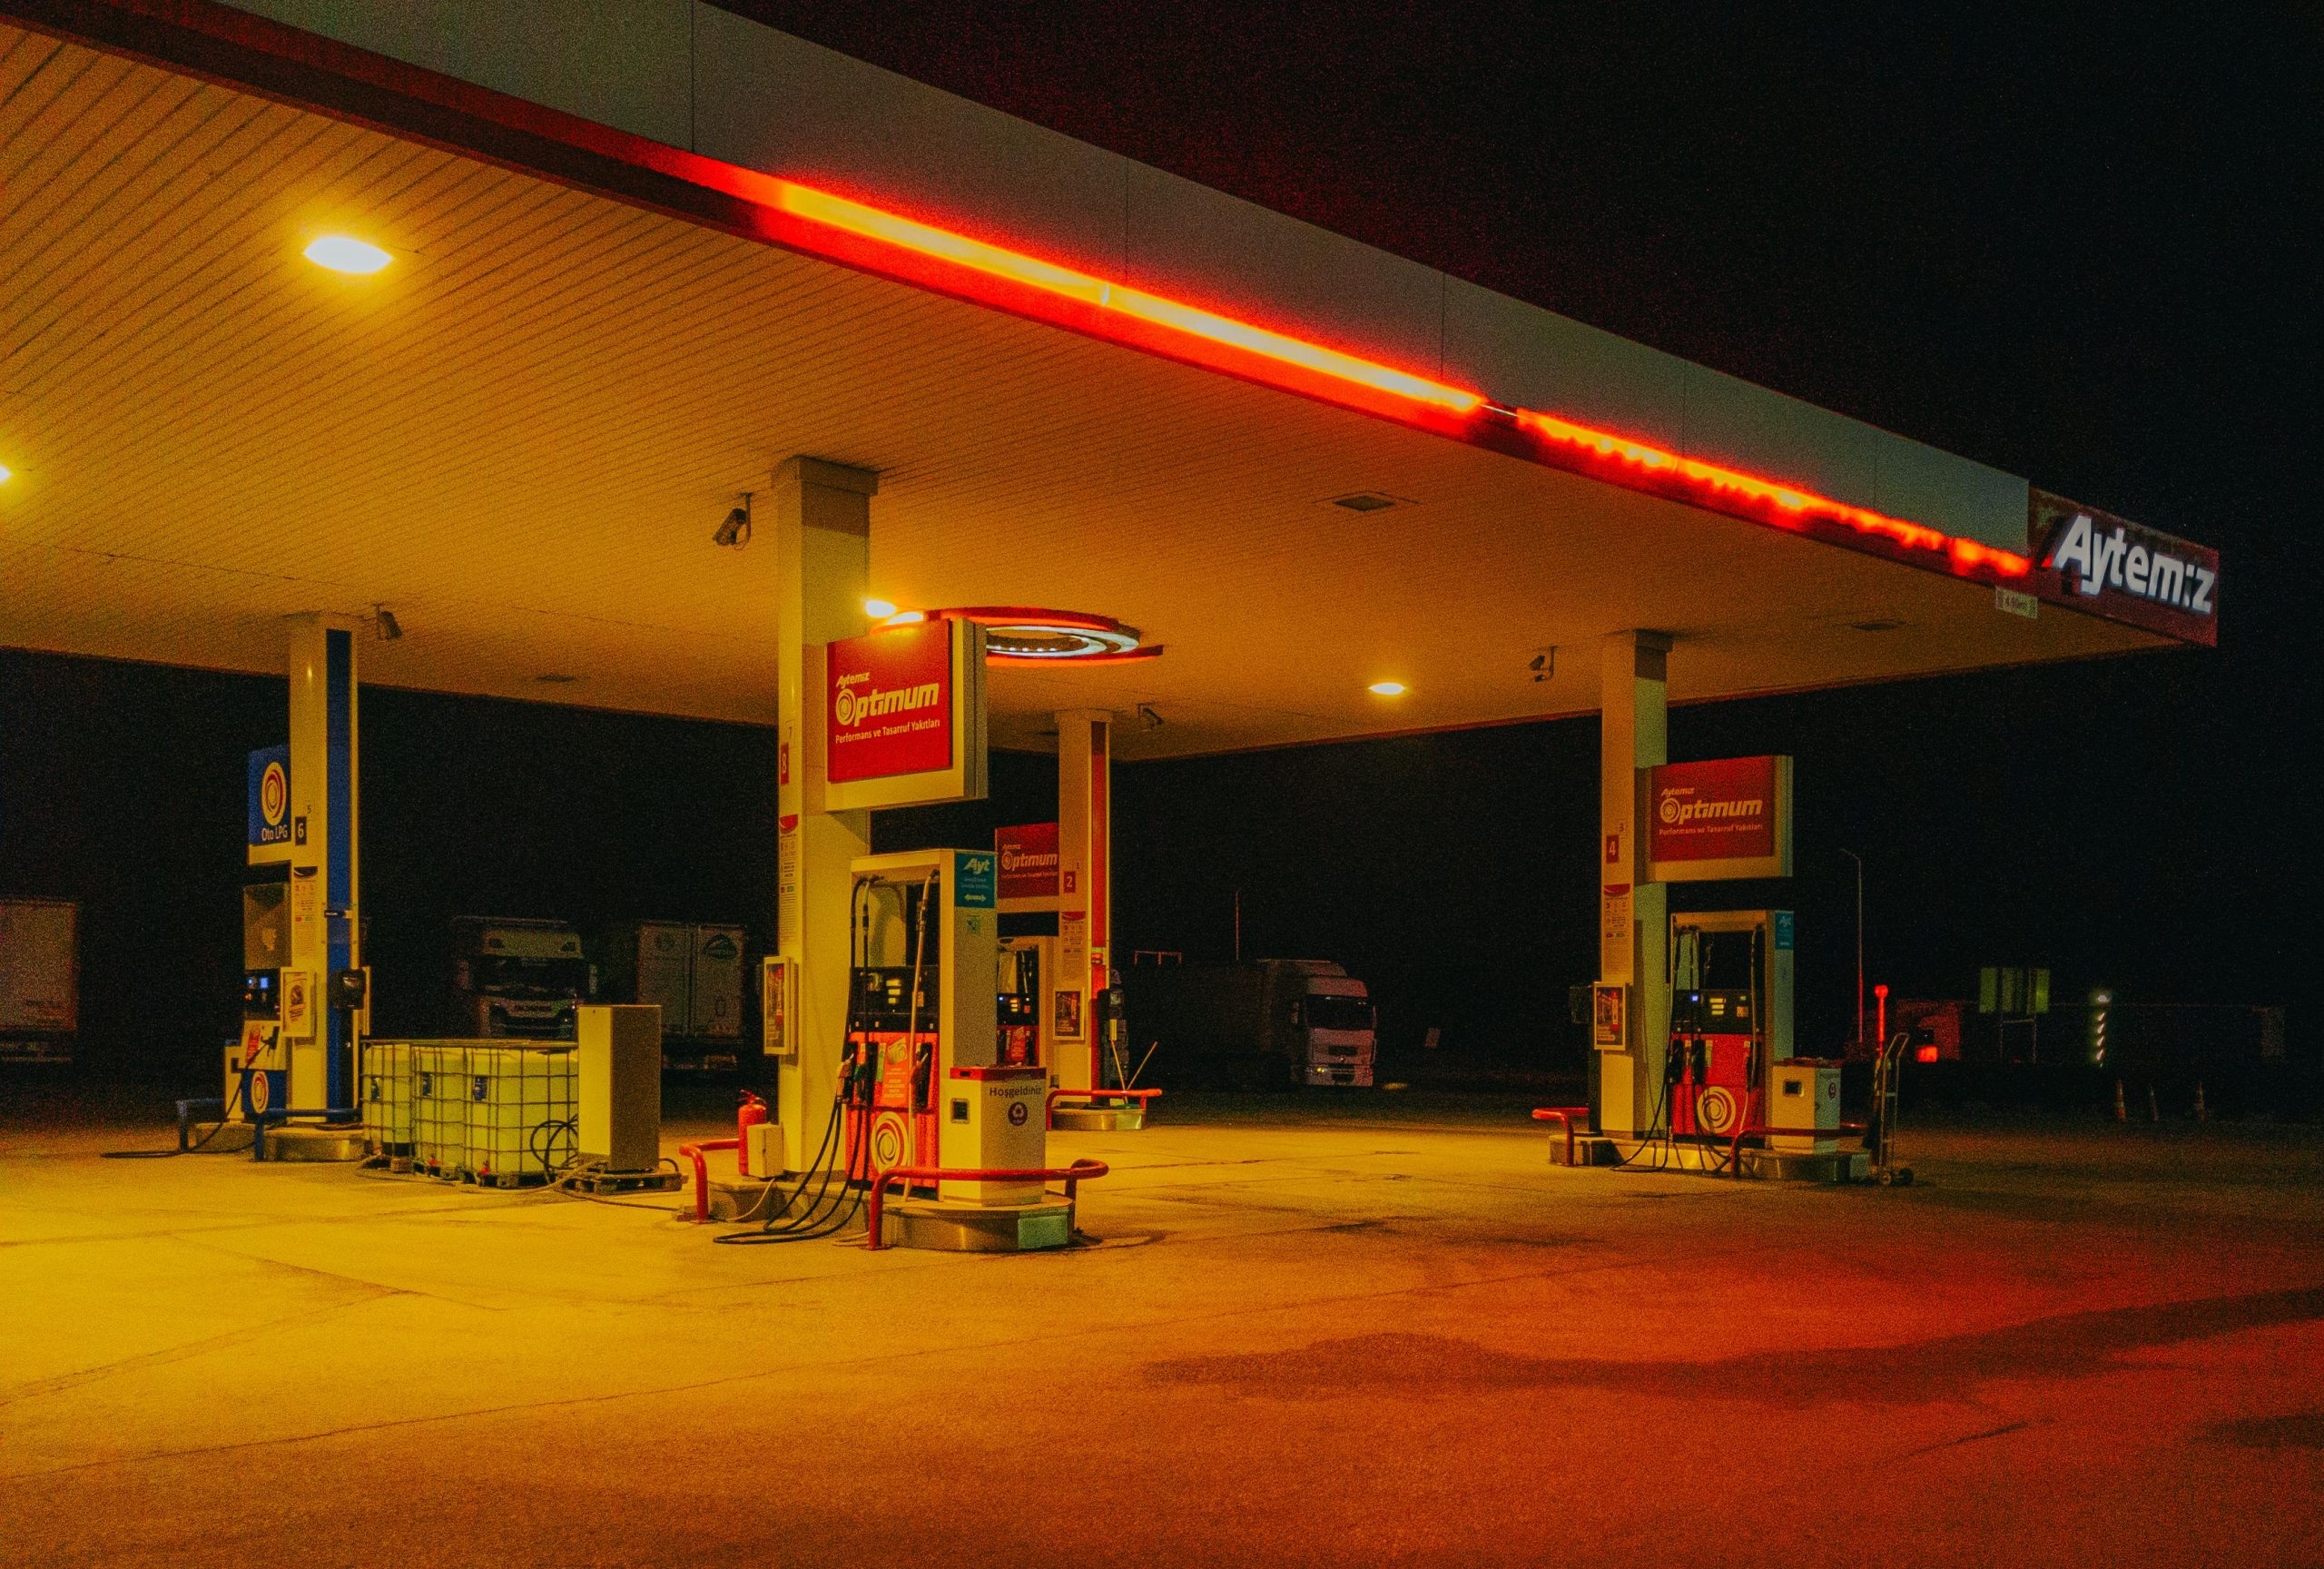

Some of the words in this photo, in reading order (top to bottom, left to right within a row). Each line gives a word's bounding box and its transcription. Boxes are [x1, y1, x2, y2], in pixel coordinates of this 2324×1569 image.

[2052, 514, 2215, 615] Aytemiz
[835, 730, 872, 744] Performans
[873, 729, 881, 737] ve
[882, 722, 911, 735] Tasarruf
[911, 718, 940, 731] Yakıtları
[782, 753, 787, 775] 8
[307, 804, 312, 814] 5
[261, 827, 274, 841] Oto
[275, 824, 288, 840] LPG
[297, 822, 304, 838] 6
[1618, 823, 1624, 833] 3
[1659, 827, 1696, 835] Performans
[1707, 824, 1734, 833] Tasarruf
[1609, 841, 1616, 856] 4
[1066, 875, 1073, 888] 2
